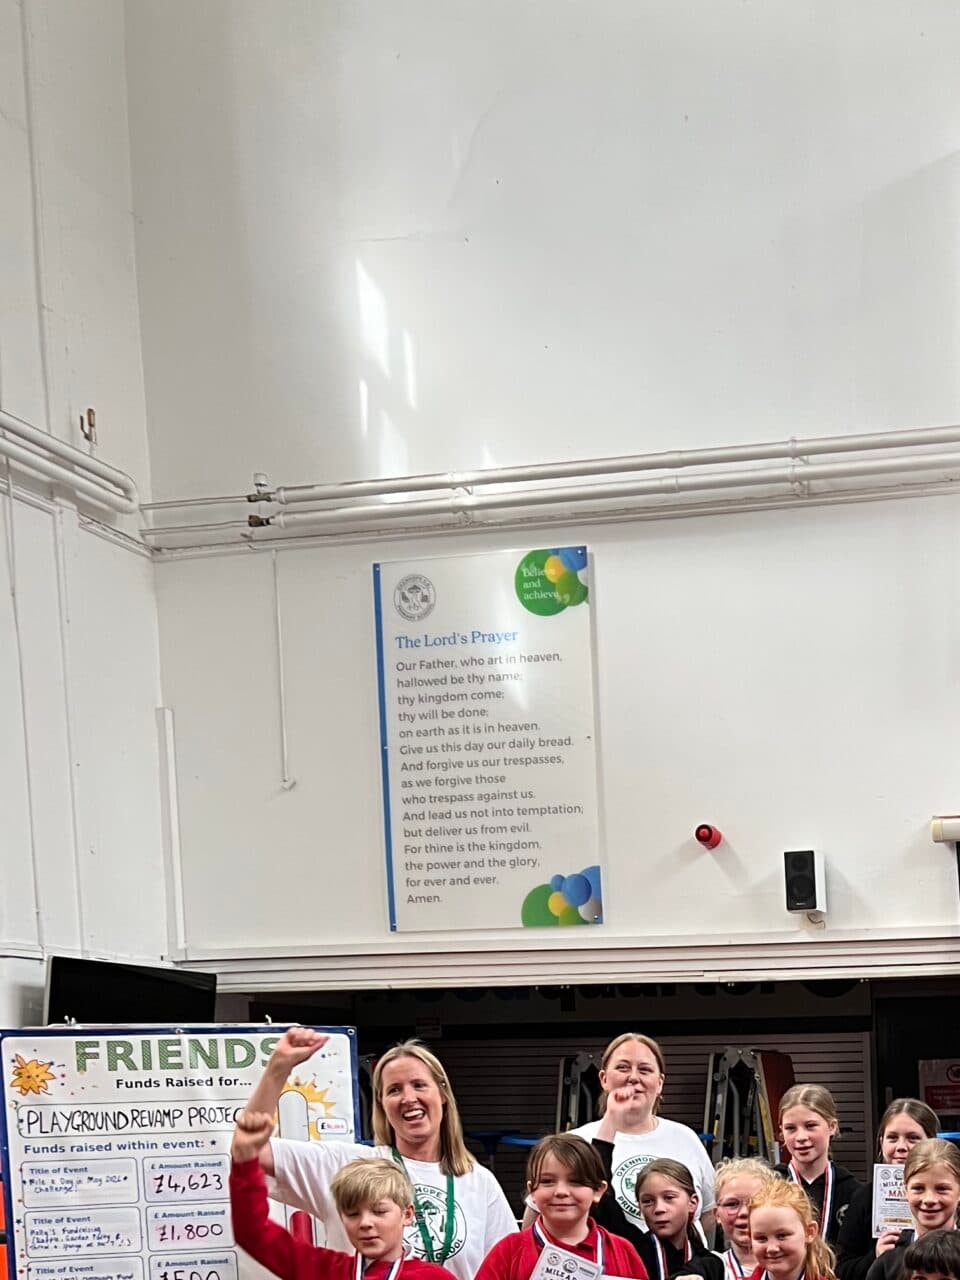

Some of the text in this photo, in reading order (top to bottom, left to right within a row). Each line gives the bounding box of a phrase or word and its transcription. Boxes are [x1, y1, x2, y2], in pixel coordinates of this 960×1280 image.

[523, 580, 541, 588] and
[395, 630, 518, 649] The Lord's Prayer
[396, 661, 416, 671] Our
[420, 659, 457, 670] Father,
[460, 657, 484, 667] who
[488, 655, 504, 665] art
[397, 676, 448, 688] hallowed
[450, 675, 465, 685] be
[467, 673, 485, 685] thy
[398, 690, 505, 706] thy kingdom come;
[399, 708, 489, 723] thy will be done;
[402, 804, 584, 821] And lead us not into temptation;
[75, 1038, 280, 1073] FRIENDS
[116, 1078, 160, 1089] Funds
[165, 1076, 213, 1088] Raised
[27, 1107, 243, 1134] PLAYGROUND REVAMP PROJEC
[24, 1140, 204, 1154] Funds raised within event:
[63, 1166, 88, 1174] Event
[158, 1162, 190, 1170] Amount
[194, 1160, 222, 1168] Raised
